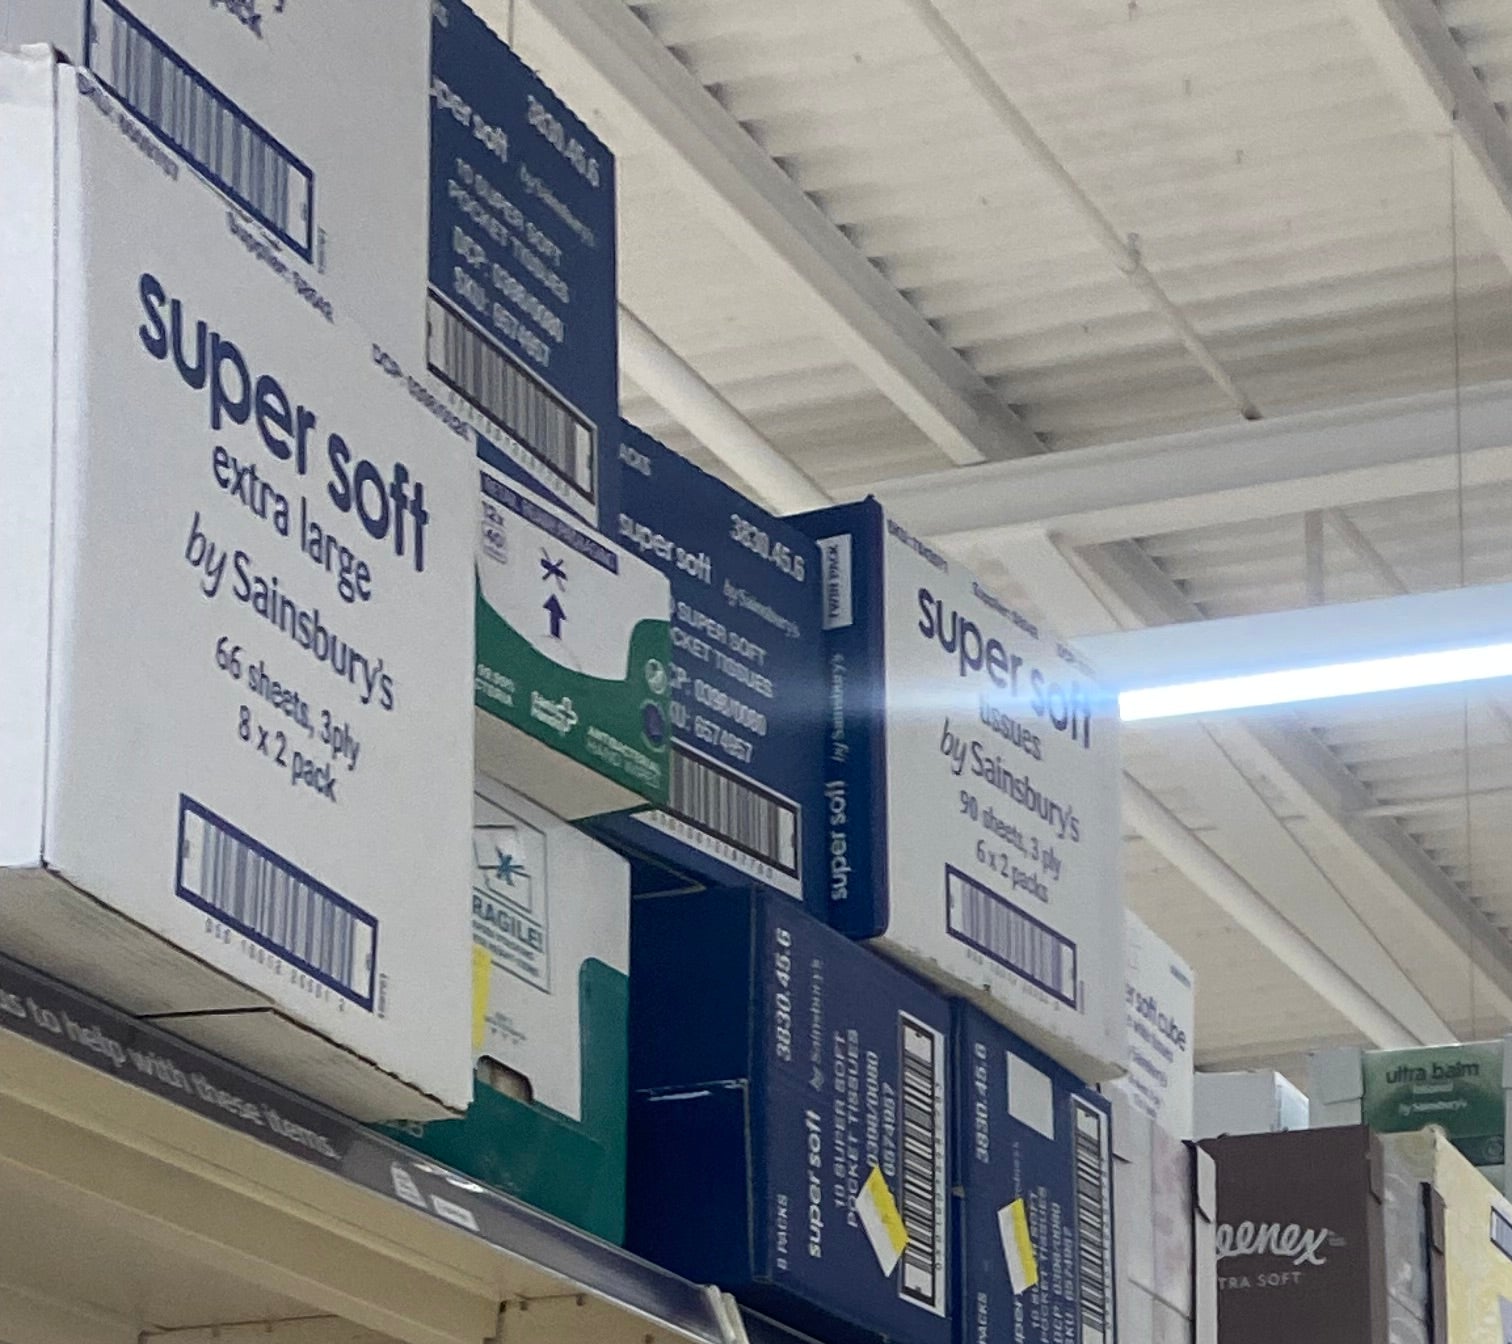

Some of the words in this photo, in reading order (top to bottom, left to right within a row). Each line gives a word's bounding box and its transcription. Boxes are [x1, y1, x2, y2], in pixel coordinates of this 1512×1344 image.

[139, 273, 315, 475] super
[327, 432, 428, 572] soft
[213, 444, 289, 536] extra
[301, 495, 372, 603] large
[619, 513, 674, 562] super
[675, 543, 712, 585] soft
[185, 512, 227, 599] by
[233, 551, 394, 711] Sainsbury's
[216, 635, 241, 680] 66
[248, 660, 314, 740] sheets,
[918, 587, 1021, 689] super
[1031, 667, 1091, 749] soft
[239, 704, 250, 741] 8
[257, 724, 268, 756] x
[274, 730, 287, 768] 2
[292, 750, 337, 803] pack
[940, 718, 966, 776] by
[971, 742, 1080, 842] Sainsbury's
[830, 779, 846, 826] soft
[831, 832, 847, 900] super
[834, 1031, 845, 1092] SOFT
[1386, 1063, 1427, 1084] ultra
[1432, 1060, 1480, 1081] balm
[807, 1109, 820, 1169] soft
[834, 1099, 845, 1178] SUPER
[809, 1176, 821, 1258] super
[1257, 1272, 1300, 1287] SOFT
